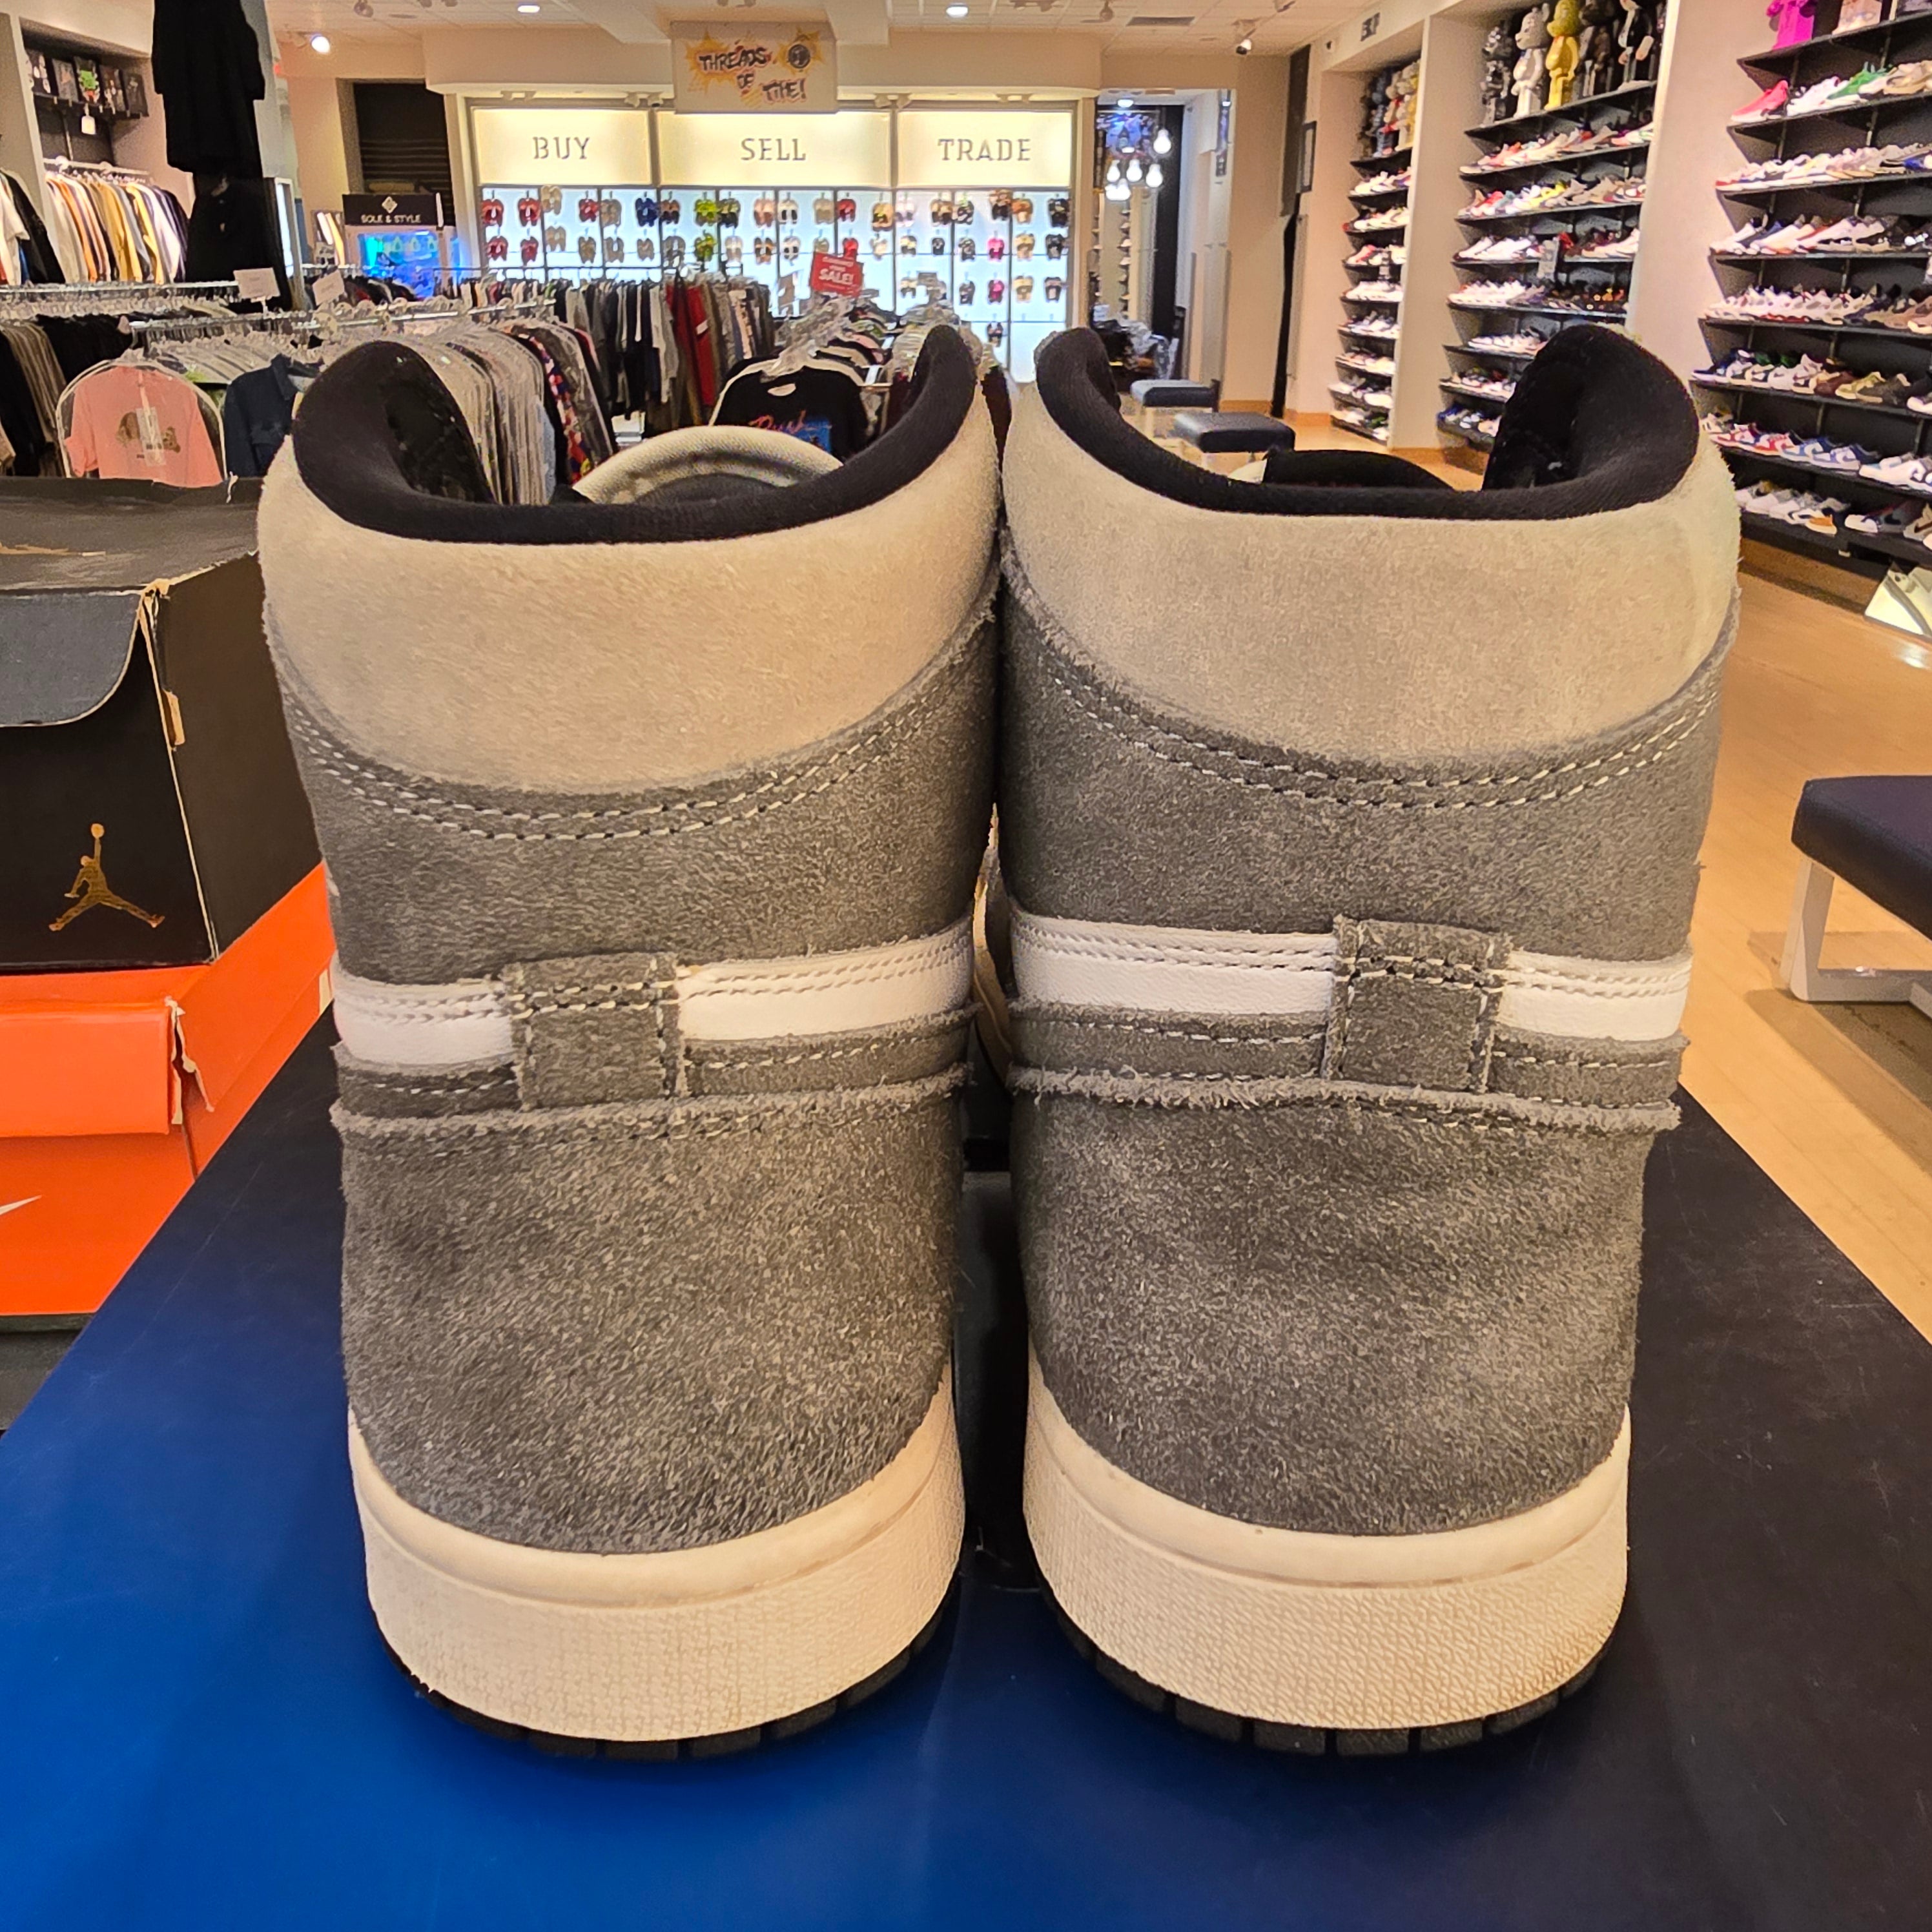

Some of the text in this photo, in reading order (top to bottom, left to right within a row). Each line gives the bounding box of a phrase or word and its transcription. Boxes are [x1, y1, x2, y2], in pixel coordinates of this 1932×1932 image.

[699, 47, 766, 71] THREADS
[533, 137, 590, 159] BUY
[741, 138, 806, 161] SELL
[937, 138, 1031, 161] TRADE
[361, 214, 384, 223] SOLE
[394, 214, 421, 223] STYLE
